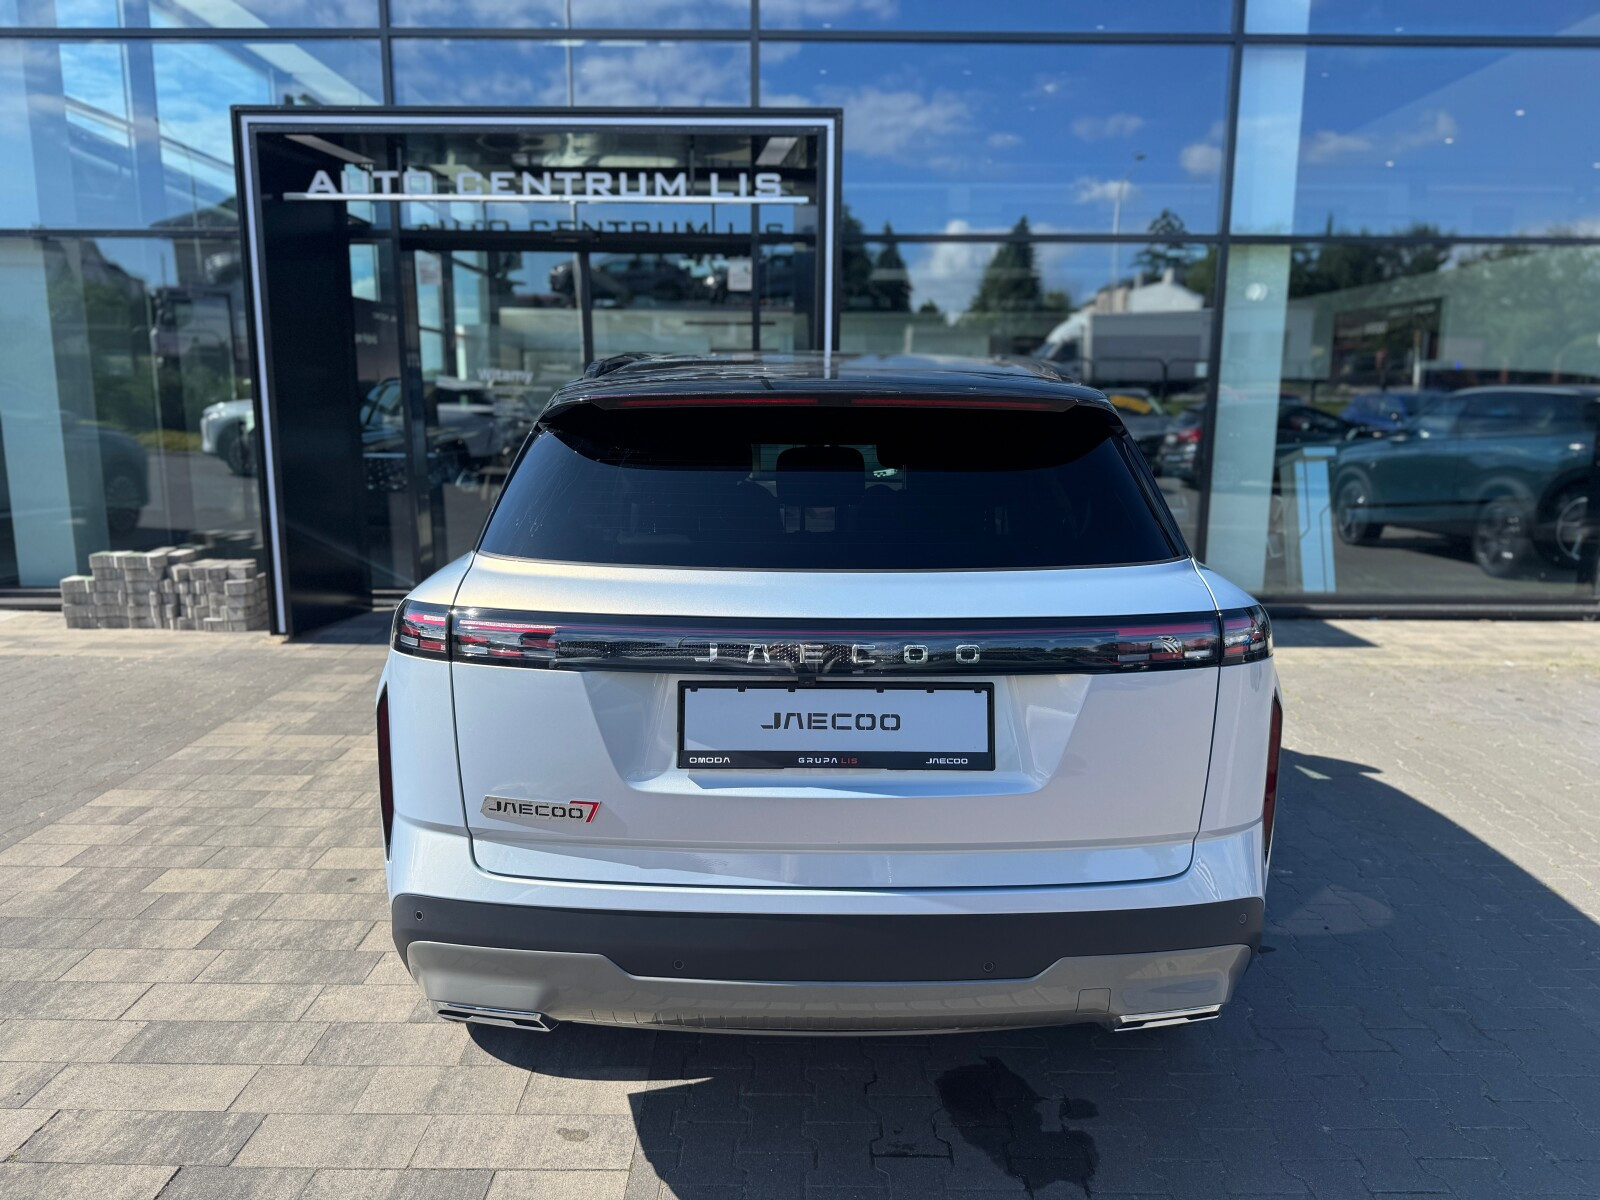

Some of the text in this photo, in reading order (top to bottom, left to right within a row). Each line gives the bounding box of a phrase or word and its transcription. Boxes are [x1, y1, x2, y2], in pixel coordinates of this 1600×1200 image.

[306, 170, 782, 197] AUTO CENTRUM LIS
[694, 643, 981, 665] JAECOO
[760, 712, 901, 731] JAECOO
[689, 756, 731, 764] OMODA
[925, 757, 968, 765] JAECOO
